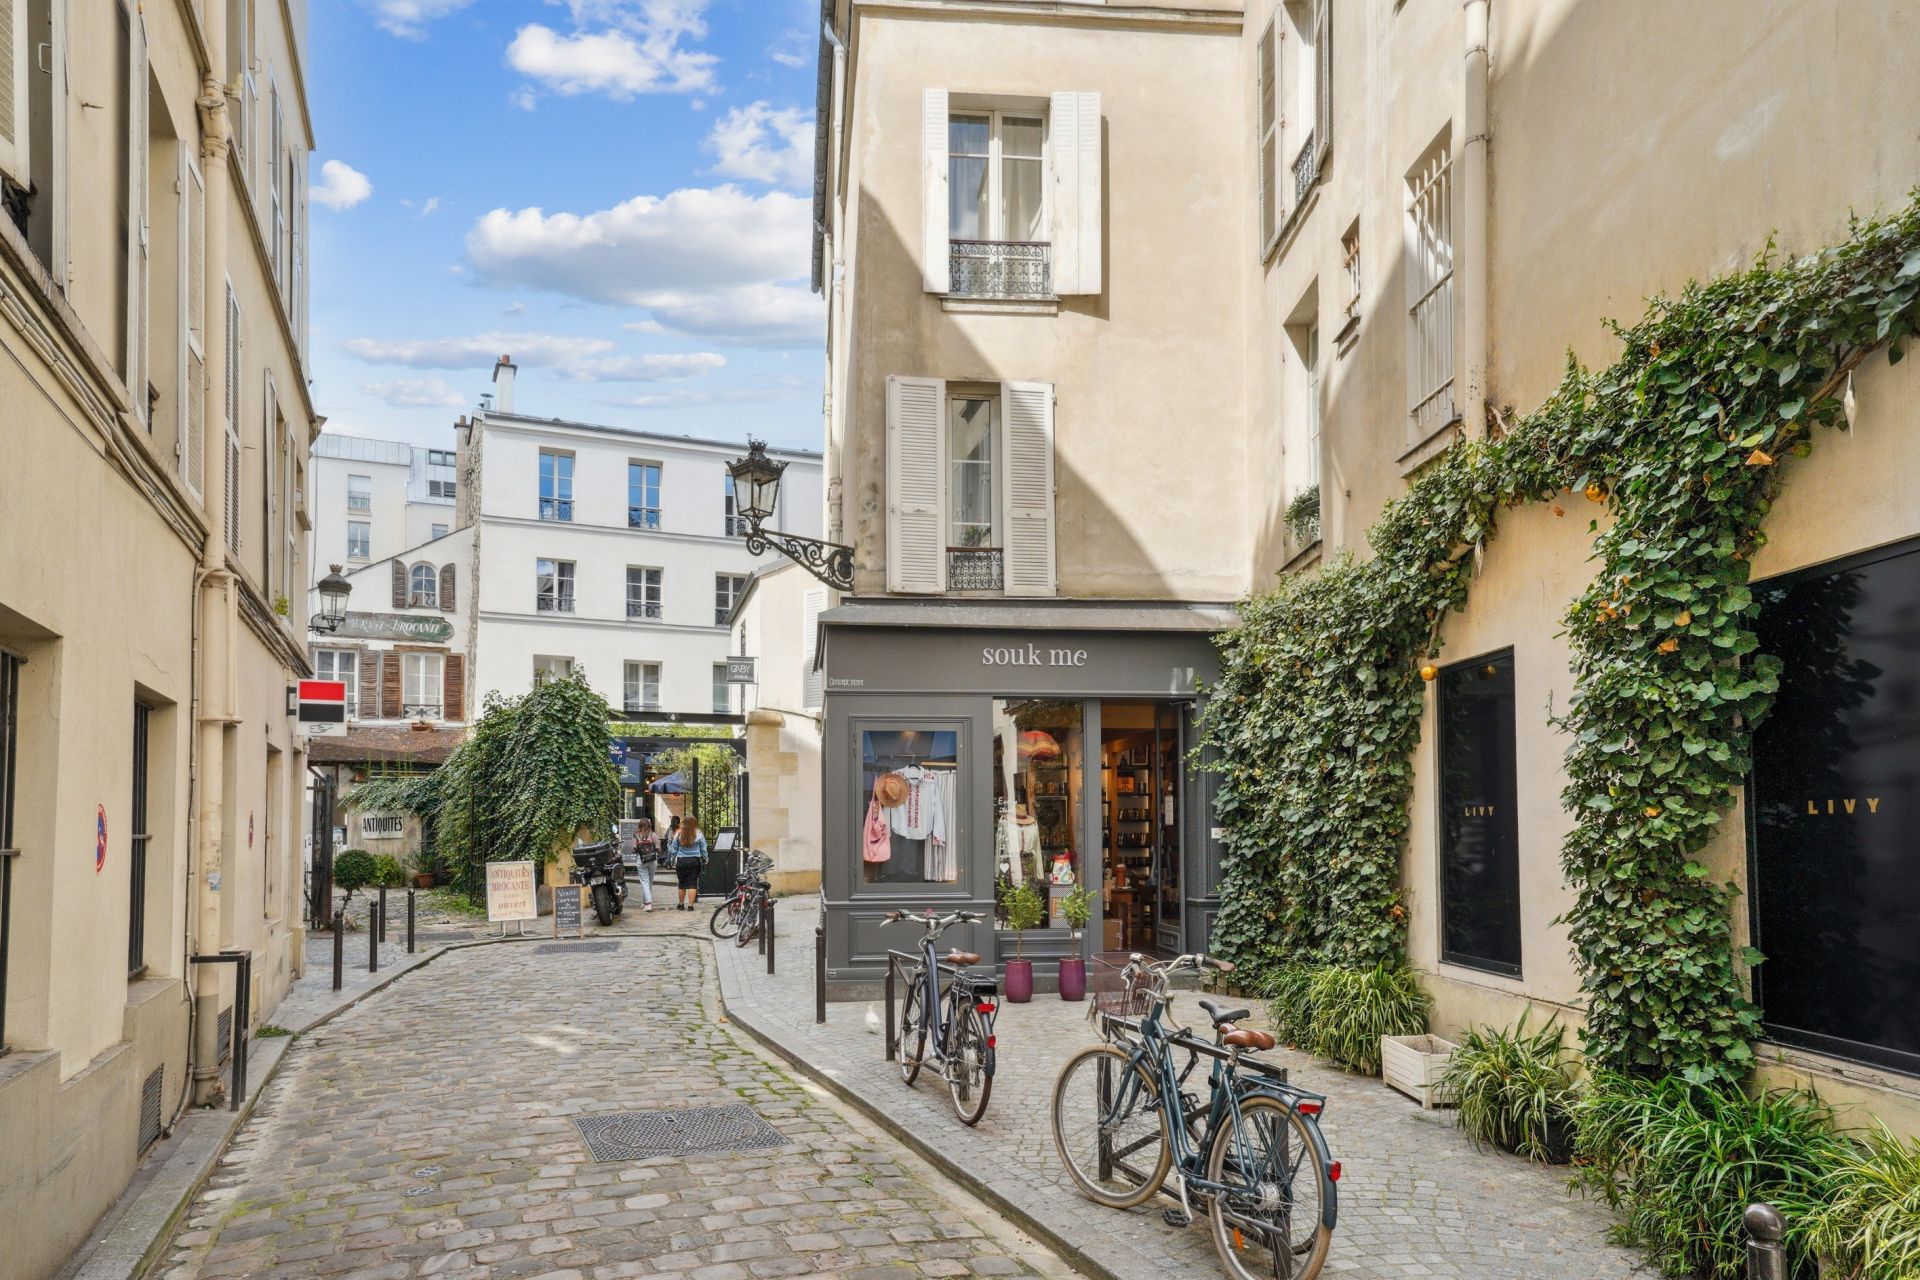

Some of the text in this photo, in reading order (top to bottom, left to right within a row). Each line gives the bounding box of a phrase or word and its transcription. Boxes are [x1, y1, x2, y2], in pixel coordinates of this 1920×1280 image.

[982, 643, 1088, 666] souk me
[730, 664, 751, 673] GABY
[1464, 805, 1494, 817] LIVY
[1807, 797, 1880, 815] LIVY
[492, 880, 530, 892] BROCANTE
